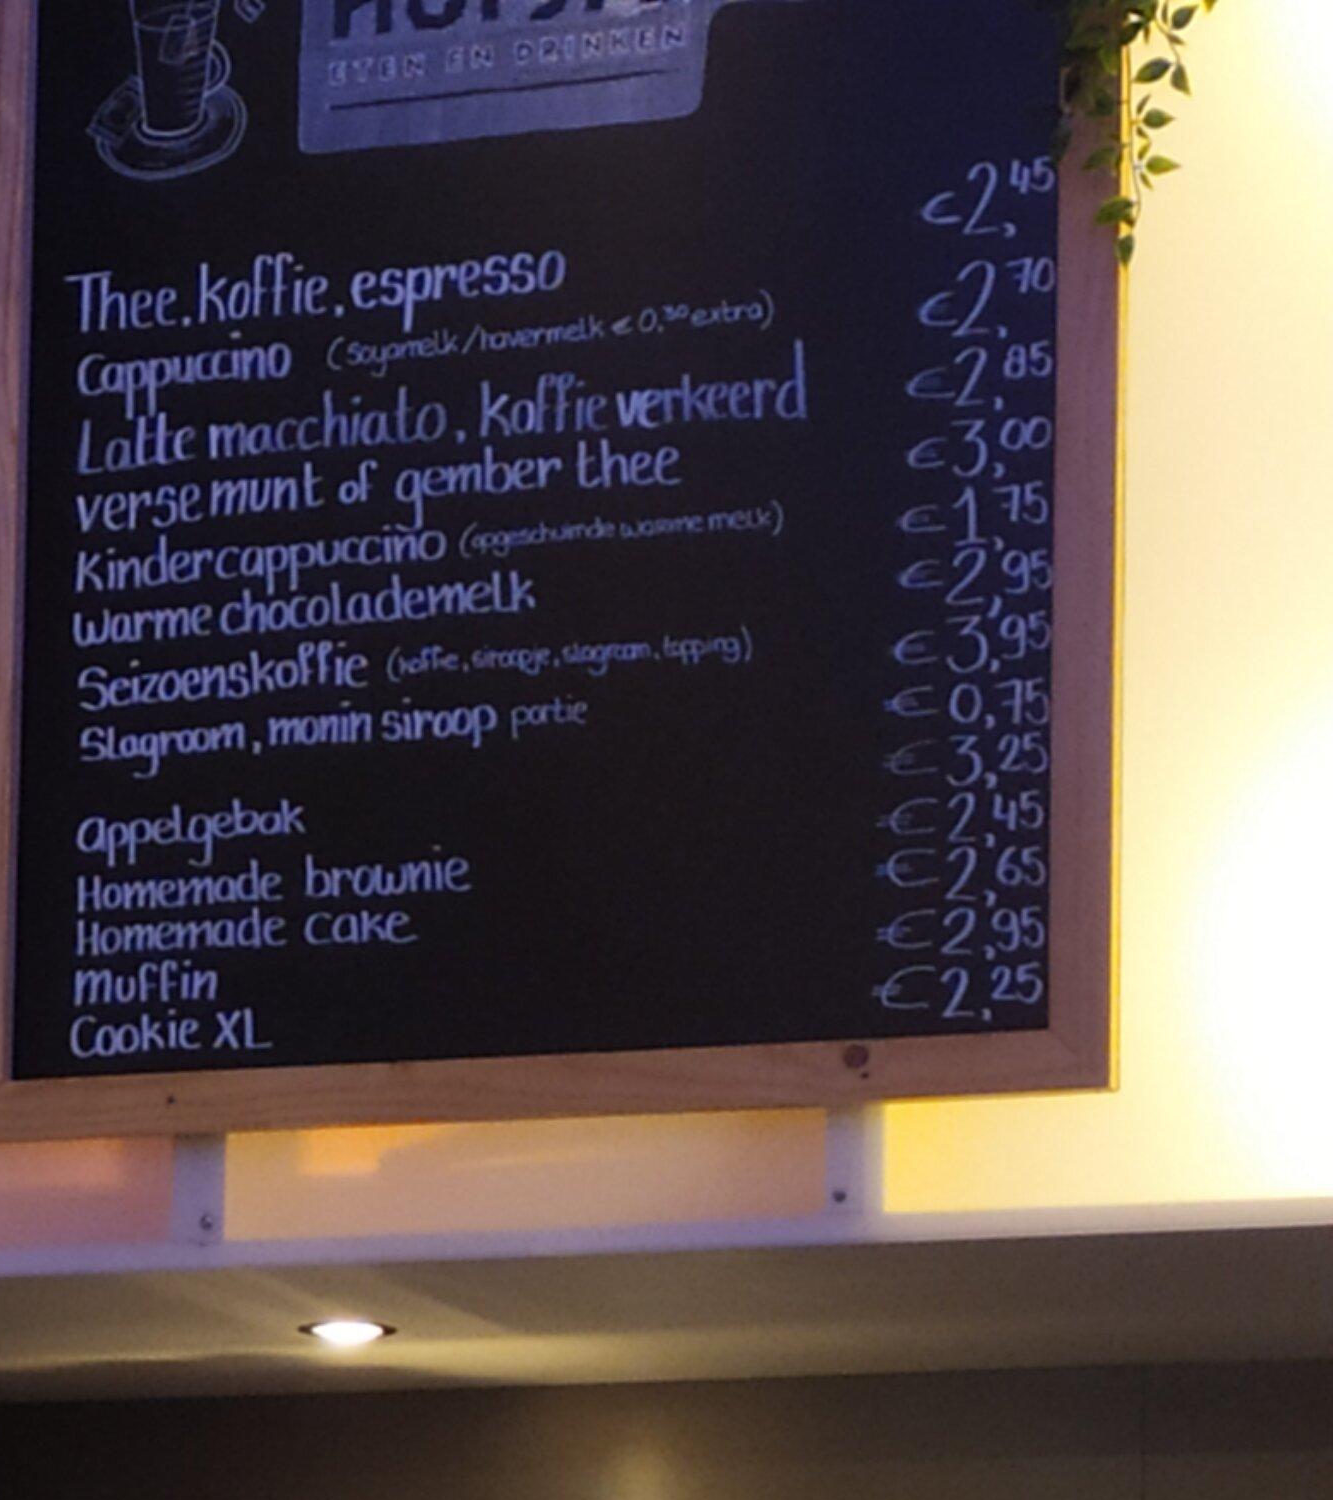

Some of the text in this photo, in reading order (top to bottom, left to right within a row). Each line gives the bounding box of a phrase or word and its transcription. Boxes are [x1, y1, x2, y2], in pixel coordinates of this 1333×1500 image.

[514, 25, 686, 66] DRINKEN
[350, 250, 567, 332] espresso
[77, 330, 292, 420] Cappuccino
[77, 411, 196, 475] Latte
[615, 339, 807, 428] verkeerd
[210, 461, 325, 517] munt
[338, 459, 378, 505] of
[395, 445, 562, 531] gember
[577, 437, 681, 488] thee
[75, 525, 447, 595] Kindercappuccino
[219, 570, 536, 635] chocolademelk
[78, 640, 369, 712] Seizoenskoffie
[267, 699, 372, 746] monin
[381, 697, 497, 749] siroop
[77, 859, 283, 913] Homemade
[304, 845, 472, 898] brownie
[76, 906, 288, 956] Homemade
[303, 909, 418, 946] cake
[70, 1009, 201, 1059] Cookie
[213, 1007, 272, 1051] XL
